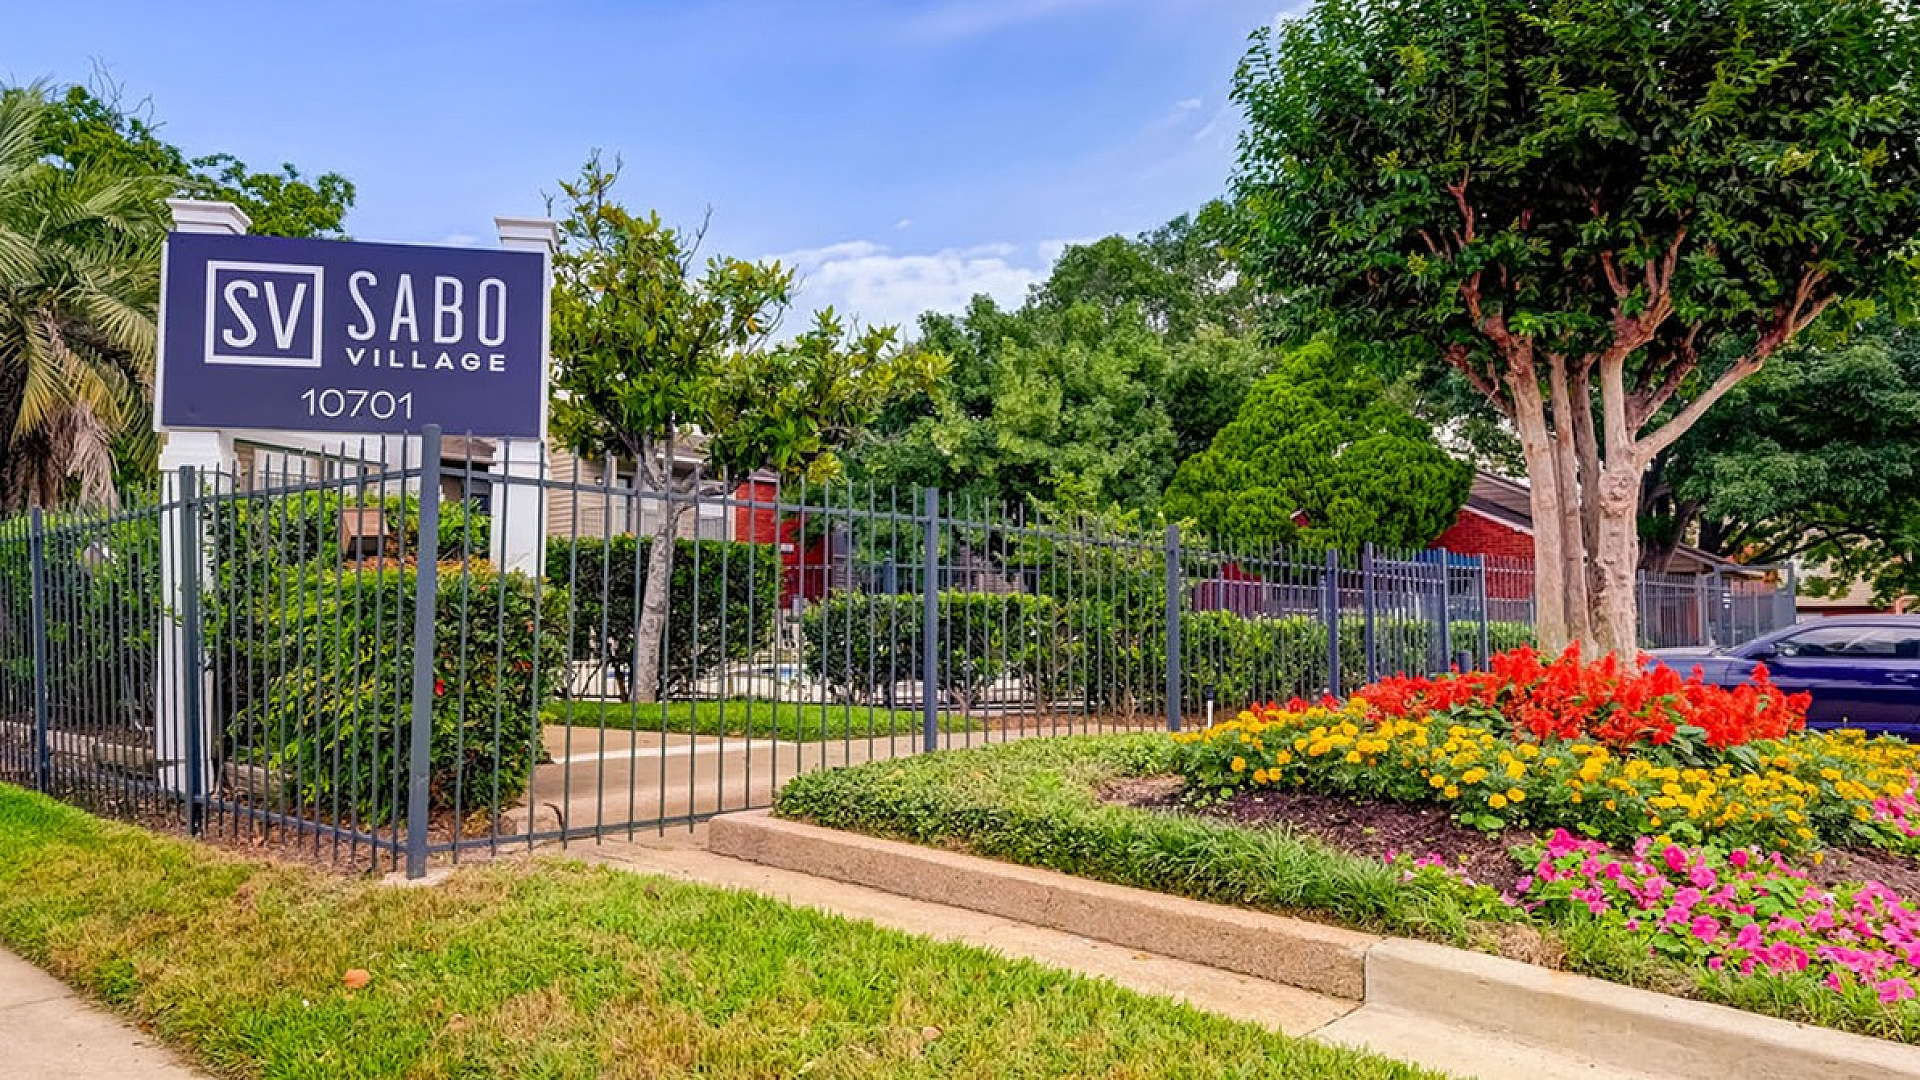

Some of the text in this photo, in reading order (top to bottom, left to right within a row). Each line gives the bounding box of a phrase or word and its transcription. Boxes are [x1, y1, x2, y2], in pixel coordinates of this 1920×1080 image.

[222, 279, 307, 349] SV
[346, 270, 507, 347] SABO
[345, 347, 506, 372] VILLAGE
[300, 387, 413, 420] 10701
